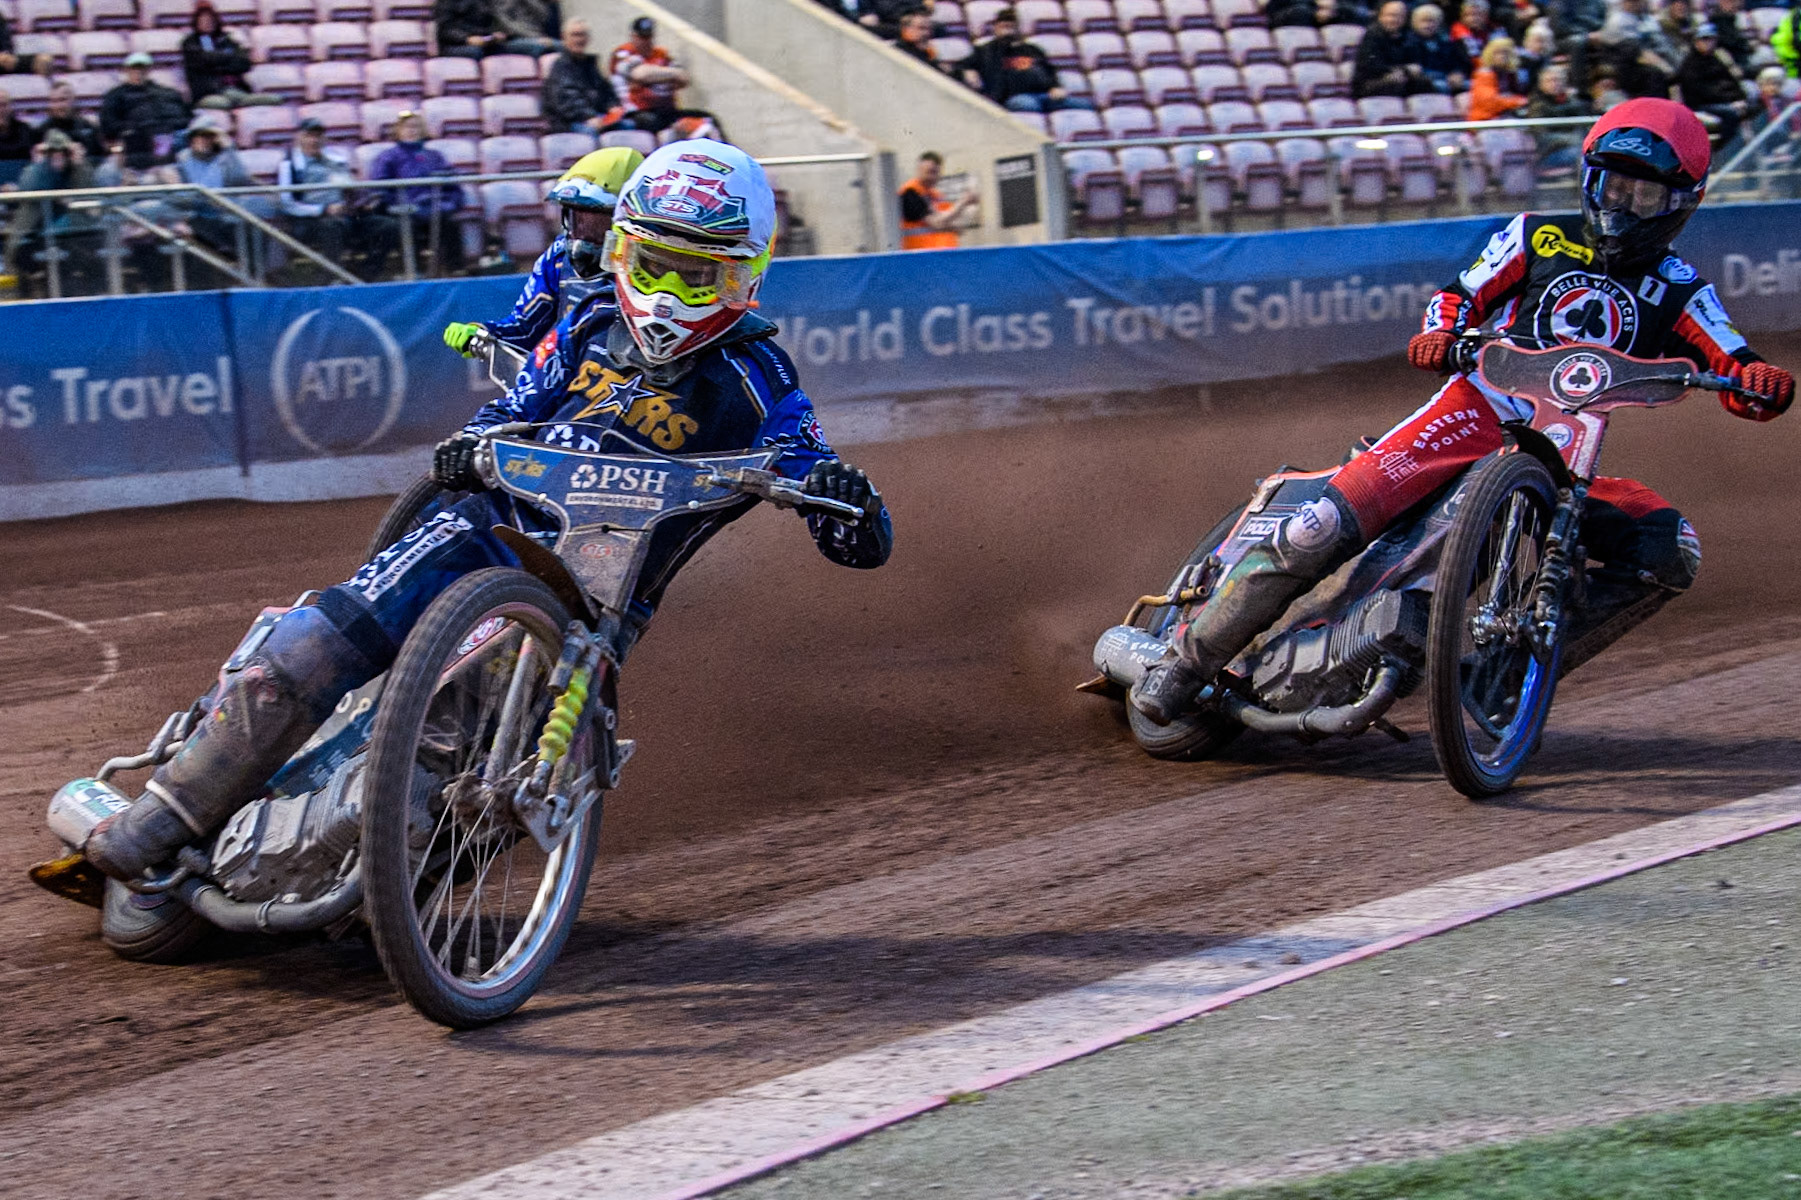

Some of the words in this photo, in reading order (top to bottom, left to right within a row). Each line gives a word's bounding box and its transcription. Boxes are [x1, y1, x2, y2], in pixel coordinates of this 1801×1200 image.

[656, 199, 696, 213] STS
[1551, 276, 1589, 298] BELLE
[1593, 279, 1620, 298] VUE
[1618, 299, 1635, 332] ACES
[1644, 280, 1659, 299] 1
[919, 303, 1054, 356] Class
[1064, 287, 1217, 346] Travel
[50, 355, 234, 424] Travel
[295, 355, 381, 402] ATPI
[775, 363, 792, 385] FLUX
[567, 359, 699, 451] STARS
[1413, 408, 1480, 450] EASTERN
[1430, 421, 1480, 452] POINT
[597, 464, 670, 495] PSH
